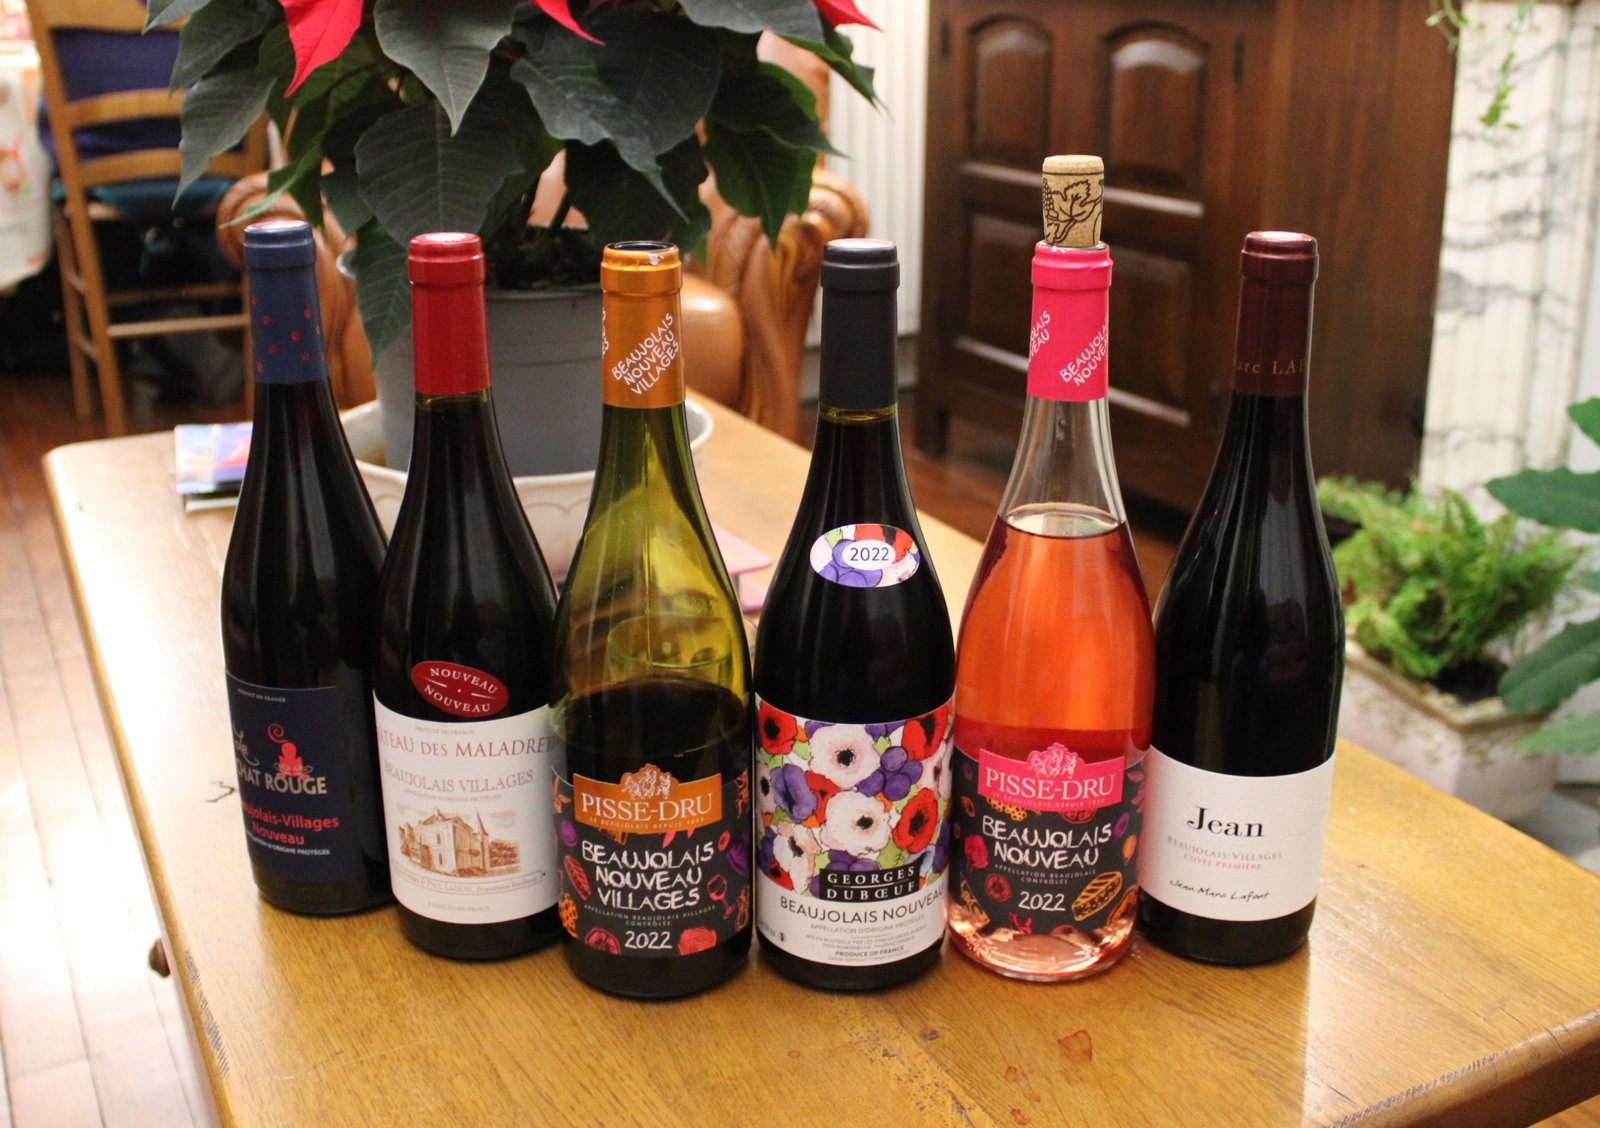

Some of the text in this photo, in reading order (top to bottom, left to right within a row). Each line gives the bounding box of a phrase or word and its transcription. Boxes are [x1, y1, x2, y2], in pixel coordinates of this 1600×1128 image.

[612, 313, 673, 380] BEAUJOLAIS
[623, 331, 674, 386] NOUVEAU
[631, 340, 679, 395] VILLAGES
[850, 547, 889, 561] 2022
[429, 667, 499, 695] NOUVEAU
[424, 684, 491, 713] NOUVEAU
[420, 741, 448, 756] DES
[264, 772, 328, 795] ROUGE
[384, 759, 534, 793] BEAUJOLAIS VILLAGES
[986, 767, 1116, 801] PISSE-DRU
[581, 792, 714, 822] PISSE-DRU
[252, 820, 305, 846] Nouveau
[982, 815, 1113, 849] BEAUJOLAIS
[1187, 805, 1265, 838] Jean
[581, 839, 715, 870] BEAUJOLAIS
[994, 842, 1099, 870] NOUVEAU
[595, 866, 703, 891] NOUVEAU
[827, 865, 915, 884] GEORGES
[994, 863, 1046, 878] APPELLATION
[584, 903, 629, 919] APPELLATION
[632, 913, 680, 921] BEAUJOLAIS
[597, 887, 700, 912] VILLAGES
[780, 895, 878, 924] BEAUJOLAIS
[1018, 890, 1066, 912] 2022
[624, 930, 673, 950] 2022
[810, 922, 857, 934] APPELLATION
[880, 945, 904, 955] FRANCE
